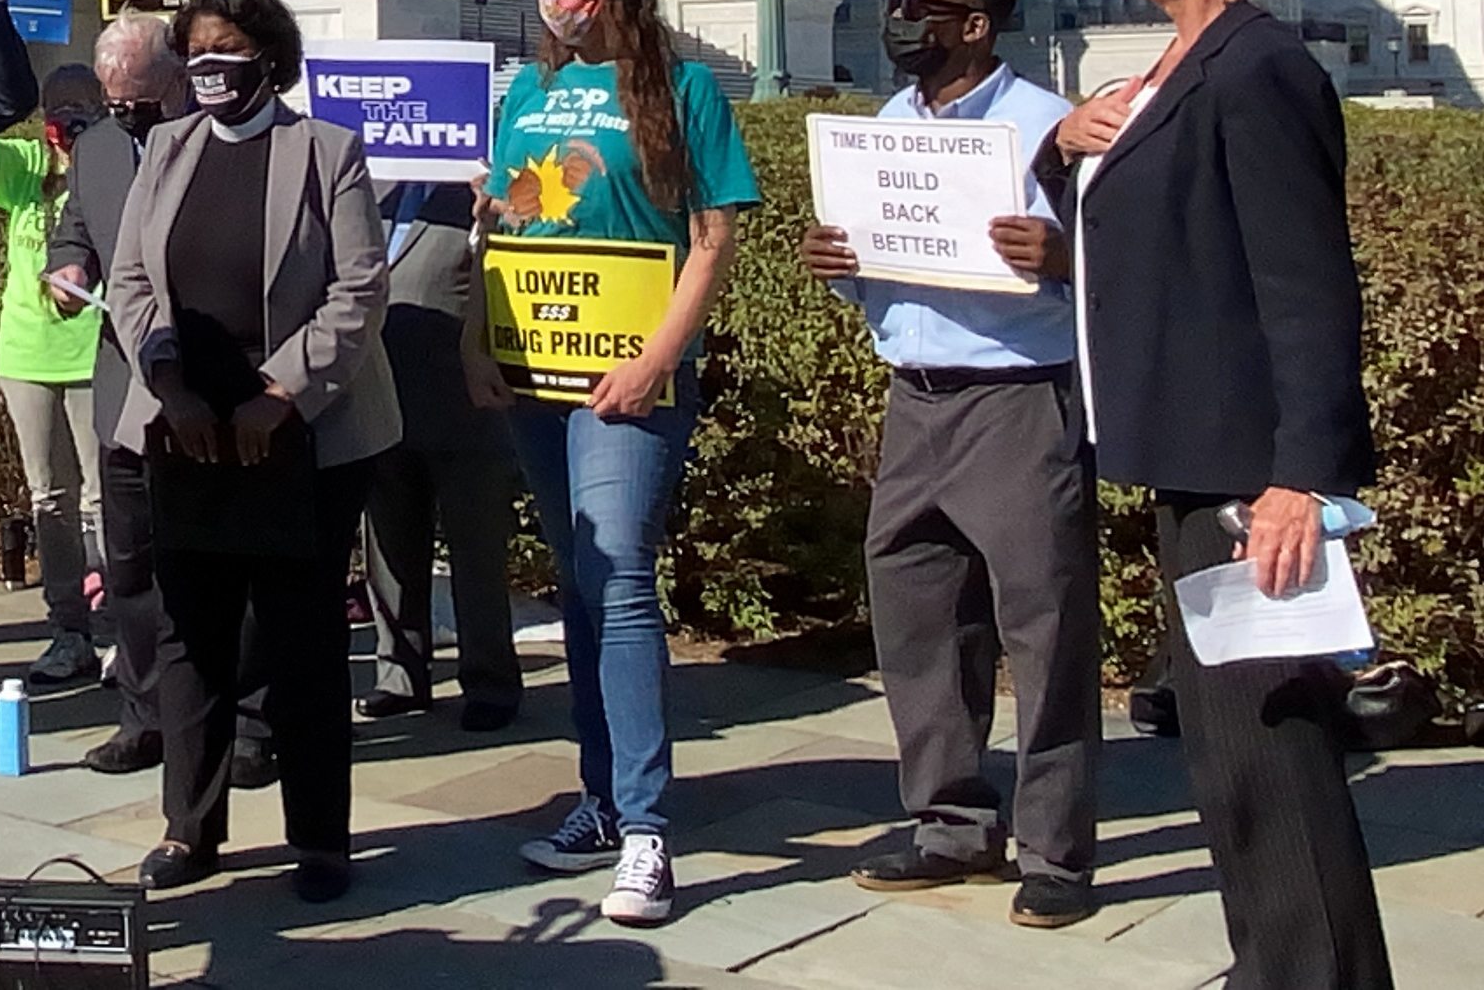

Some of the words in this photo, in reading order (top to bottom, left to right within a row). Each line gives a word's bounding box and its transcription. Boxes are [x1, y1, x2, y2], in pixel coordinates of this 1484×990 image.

[316, 74, 412, 99] KEEP
[361, 101, 428, 123] THE
[363, 122, 477, 147] FAITH
[830, 130, 867, 150] TIME
[871, 134, 896, 152] TO
[902, 136, 992, 156] DELIVER:
[878, 170, 939, 191] BUILD
[882, 202, 941, 224] BACK
[872, 233, 958, 258] BETTER!
[515, 269, 600, 297] LOWER
[494, 324, 543, 354] DRUG
[550, 331, 644, 359] PRICES
